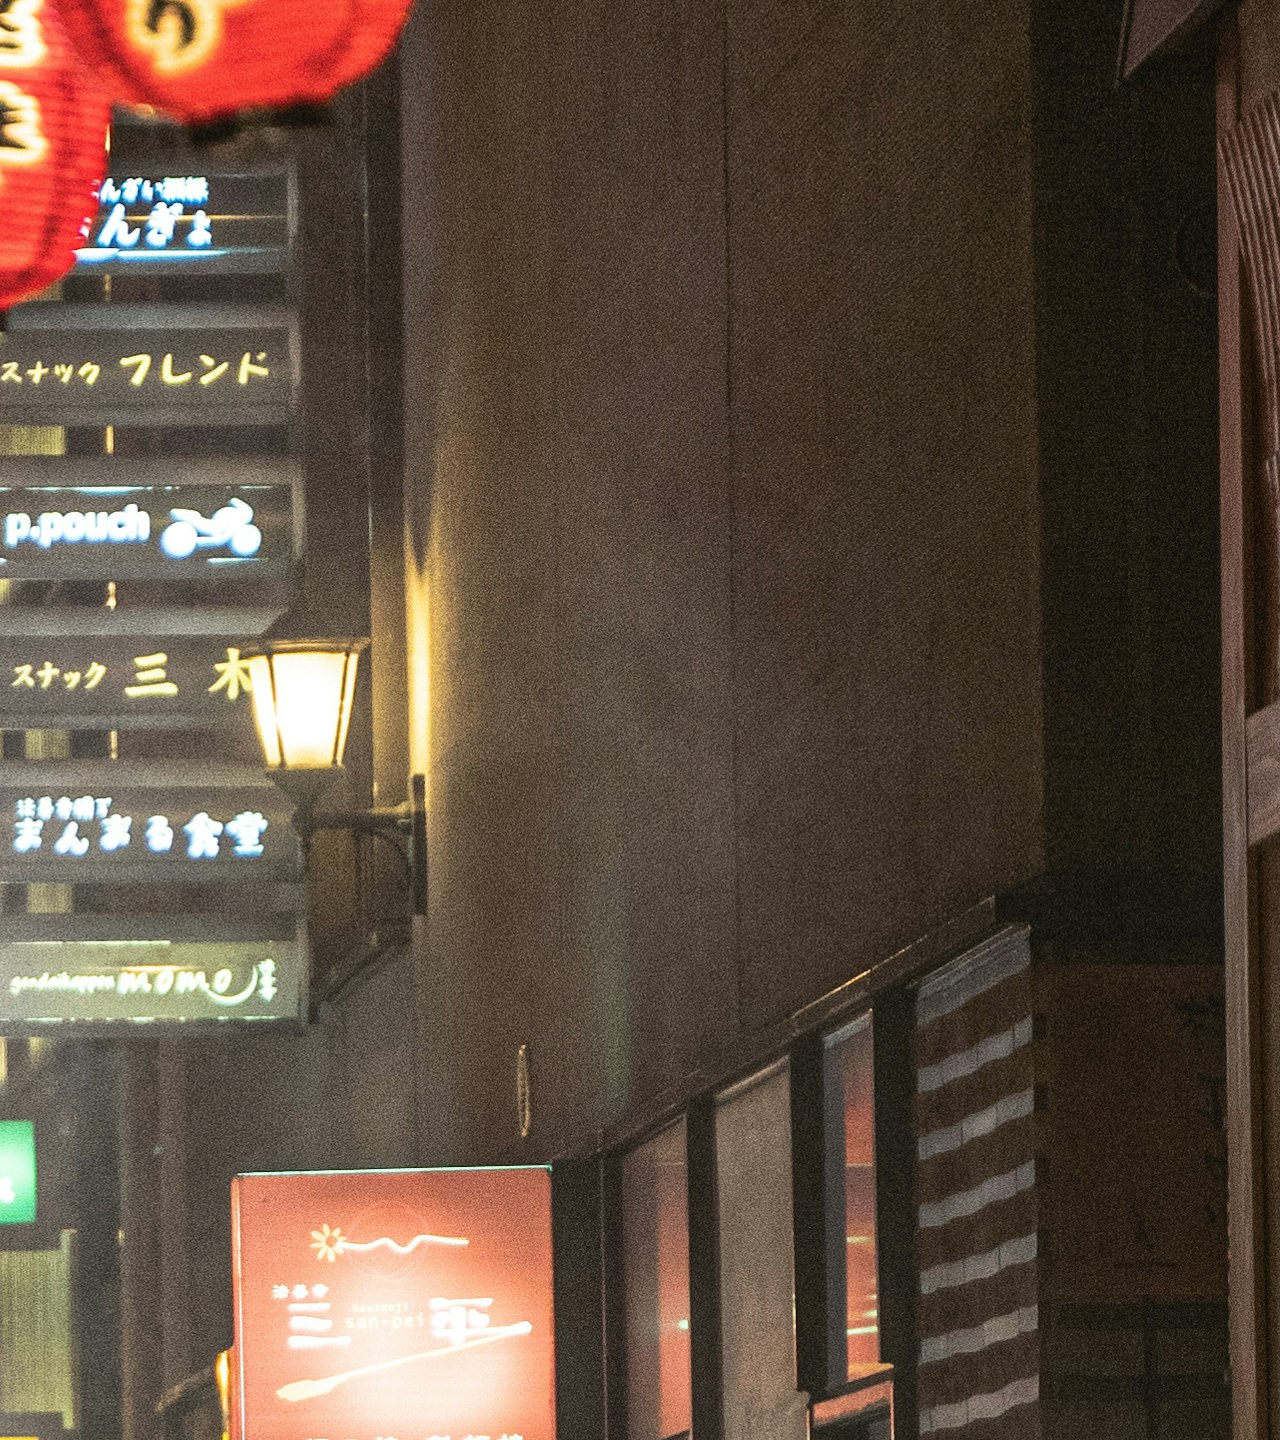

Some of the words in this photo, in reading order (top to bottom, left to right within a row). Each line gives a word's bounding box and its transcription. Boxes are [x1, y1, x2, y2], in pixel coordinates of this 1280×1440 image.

[78, 202, 212, 249] んぎょ
[0, 361, 100, 385] スナック
[119, 352, 269, 385] フレンド
[4, 503, 151, 549] p.pouch
[12, 661, 107, 689] スナック
[13, 811, 268, 858] まんまる食堂
[117, 967, 234, 994] momo
